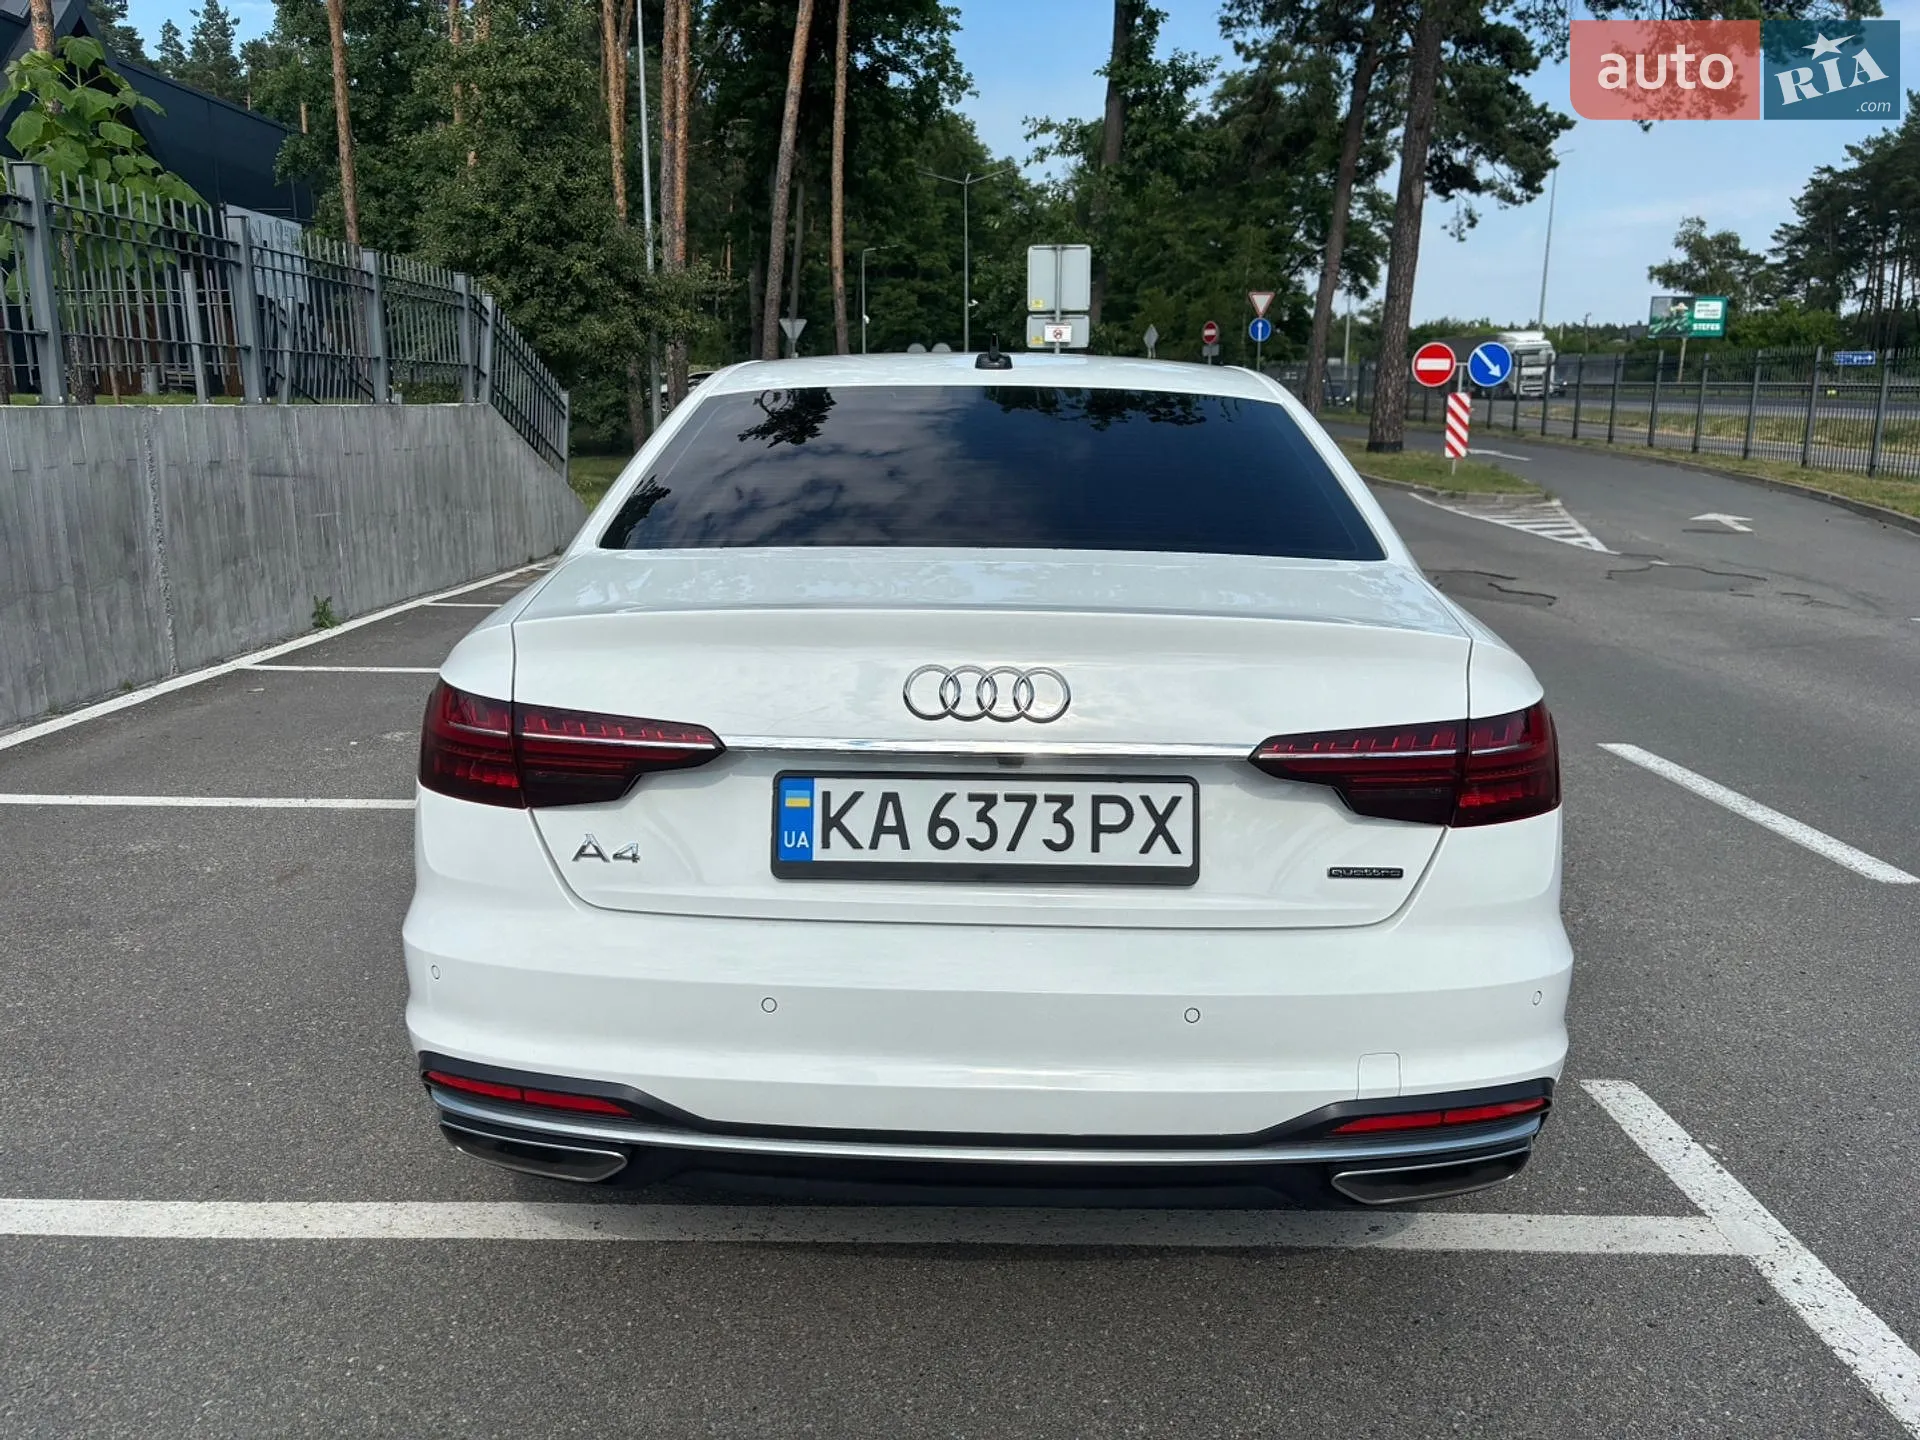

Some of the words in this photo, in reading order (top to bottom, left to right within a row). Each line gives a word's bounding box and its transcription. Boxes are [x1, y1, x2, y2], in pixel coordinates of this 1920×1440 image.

[821, 790, 911, 851] KA
[927, 791, 1075, 852] 6373
[1090, 794, 1183, 855] PX
[571, 833, 641, 863] A4
[783, 830, 810, 848] UA
[1331, 868, 1401, 877] quattro
